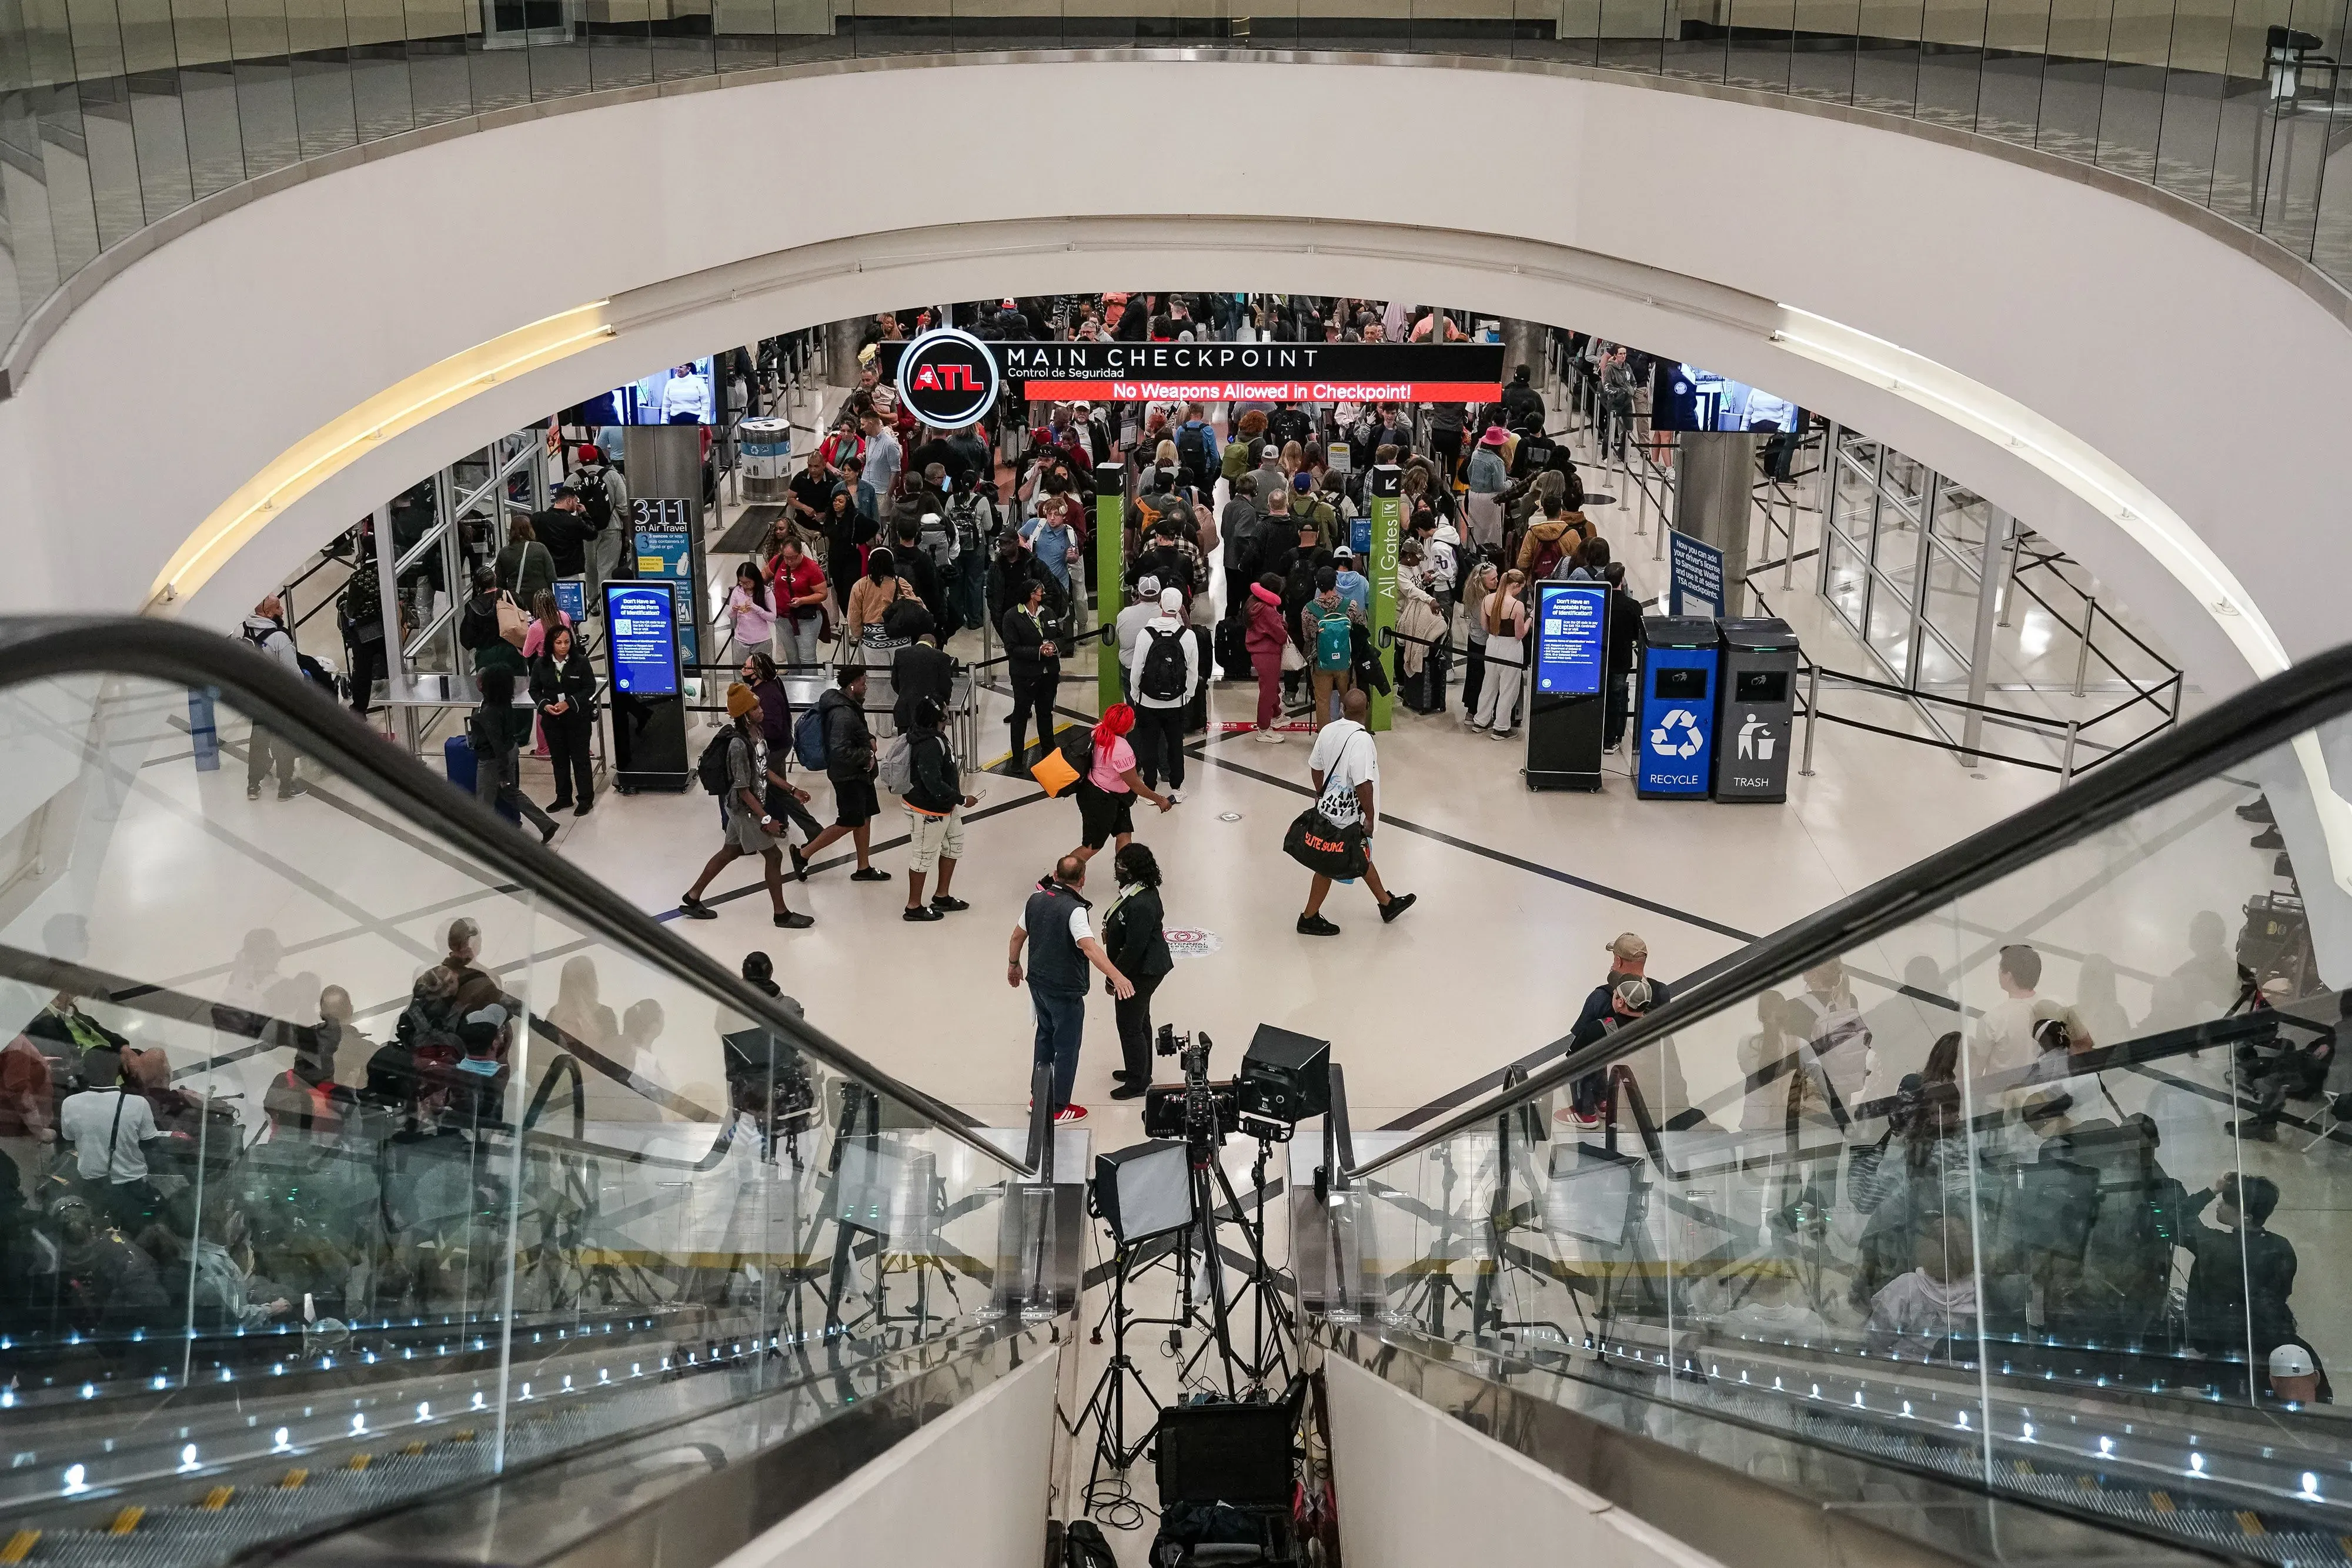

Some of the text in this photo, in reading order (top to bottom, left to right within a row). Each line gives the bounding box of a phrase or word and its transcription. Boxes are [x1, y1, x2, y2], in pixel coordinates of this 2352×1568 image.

[1008, 349, 1318, 367] MAIN CHECKPOINT
[913, 364, 984, 391] ATL
[1008, 368, 1124, 379] Control de Seguridad
[1114, 383, 1411, 402] No Weapons Allowed in Checkpoint!
[633, 499, 687, 524] 3-1-1
[641, 535, 649, 549] 3
[1676, 540, 1688, 550] Now
[1688, 546, 1697, 555] you
[1708, 554, 1717, 563] add
[1378, 519, 1398, 599] All Gates
[1673, 549, 1720, 574] your driver's license
[1676, 567, 1685, 576] and
[1695, 574, 1698, 583] it
[1705, 580, 1719, 591] select
[1682, 560, 1703, 576] Samsung
[1703, 570, 1719, 582] Wallet
[1678, 576, 1718, 599] TSA checkpoints.
[1650, 774, 1698, 784] RECYCLE
[1733, 777, 1769, 787] TRASH
[1321, 800, 1347, 816] STAY
